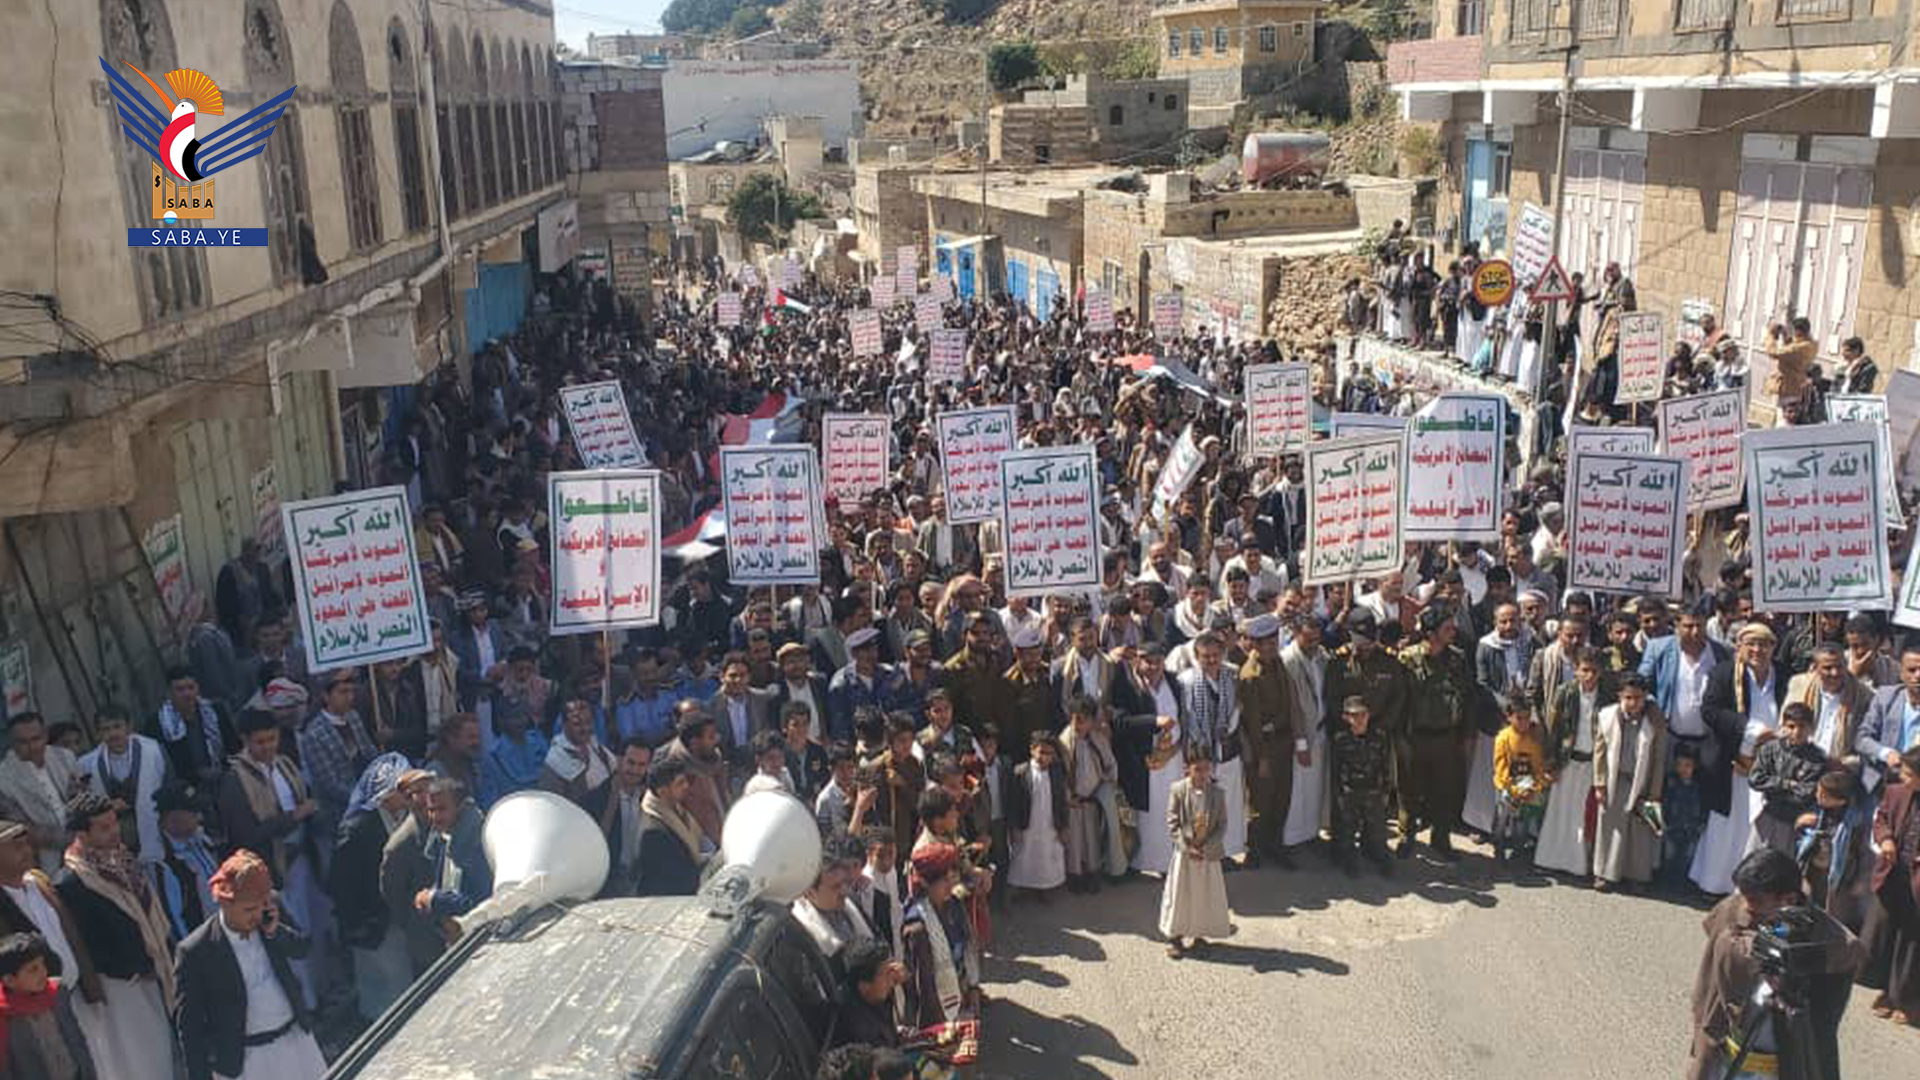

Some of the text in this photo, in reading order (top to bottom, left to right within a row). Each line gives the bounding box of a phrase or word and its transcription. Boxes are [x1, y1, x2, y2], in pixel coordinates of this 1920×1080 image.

[1480, 270, 1508, 282] STOP
[730, 457, 806, 486] الله أكبر
[1008, 459, 1088, 492] الله أكبر
[1318, 450, 1396, 486] الله أكبر
[1582, 462, 1638, 492] أكبر
[1639, 468, 1674, 490] الله
[1764, 450, 1869, 489] الله أكبر
[364, 504, 400, 532] الله
[558, 488, 649, 522] قاطعوا
[302, 506, 358, 548] أكبر
[1013, 553, 1093, 583] النصر للإسلام
[1576, 560, 1667, 587] النصر للإسلام
[1767, 562, 1875, 596] النصر للإسلام
[319, 613, 419, 654] النصر للإسلام
